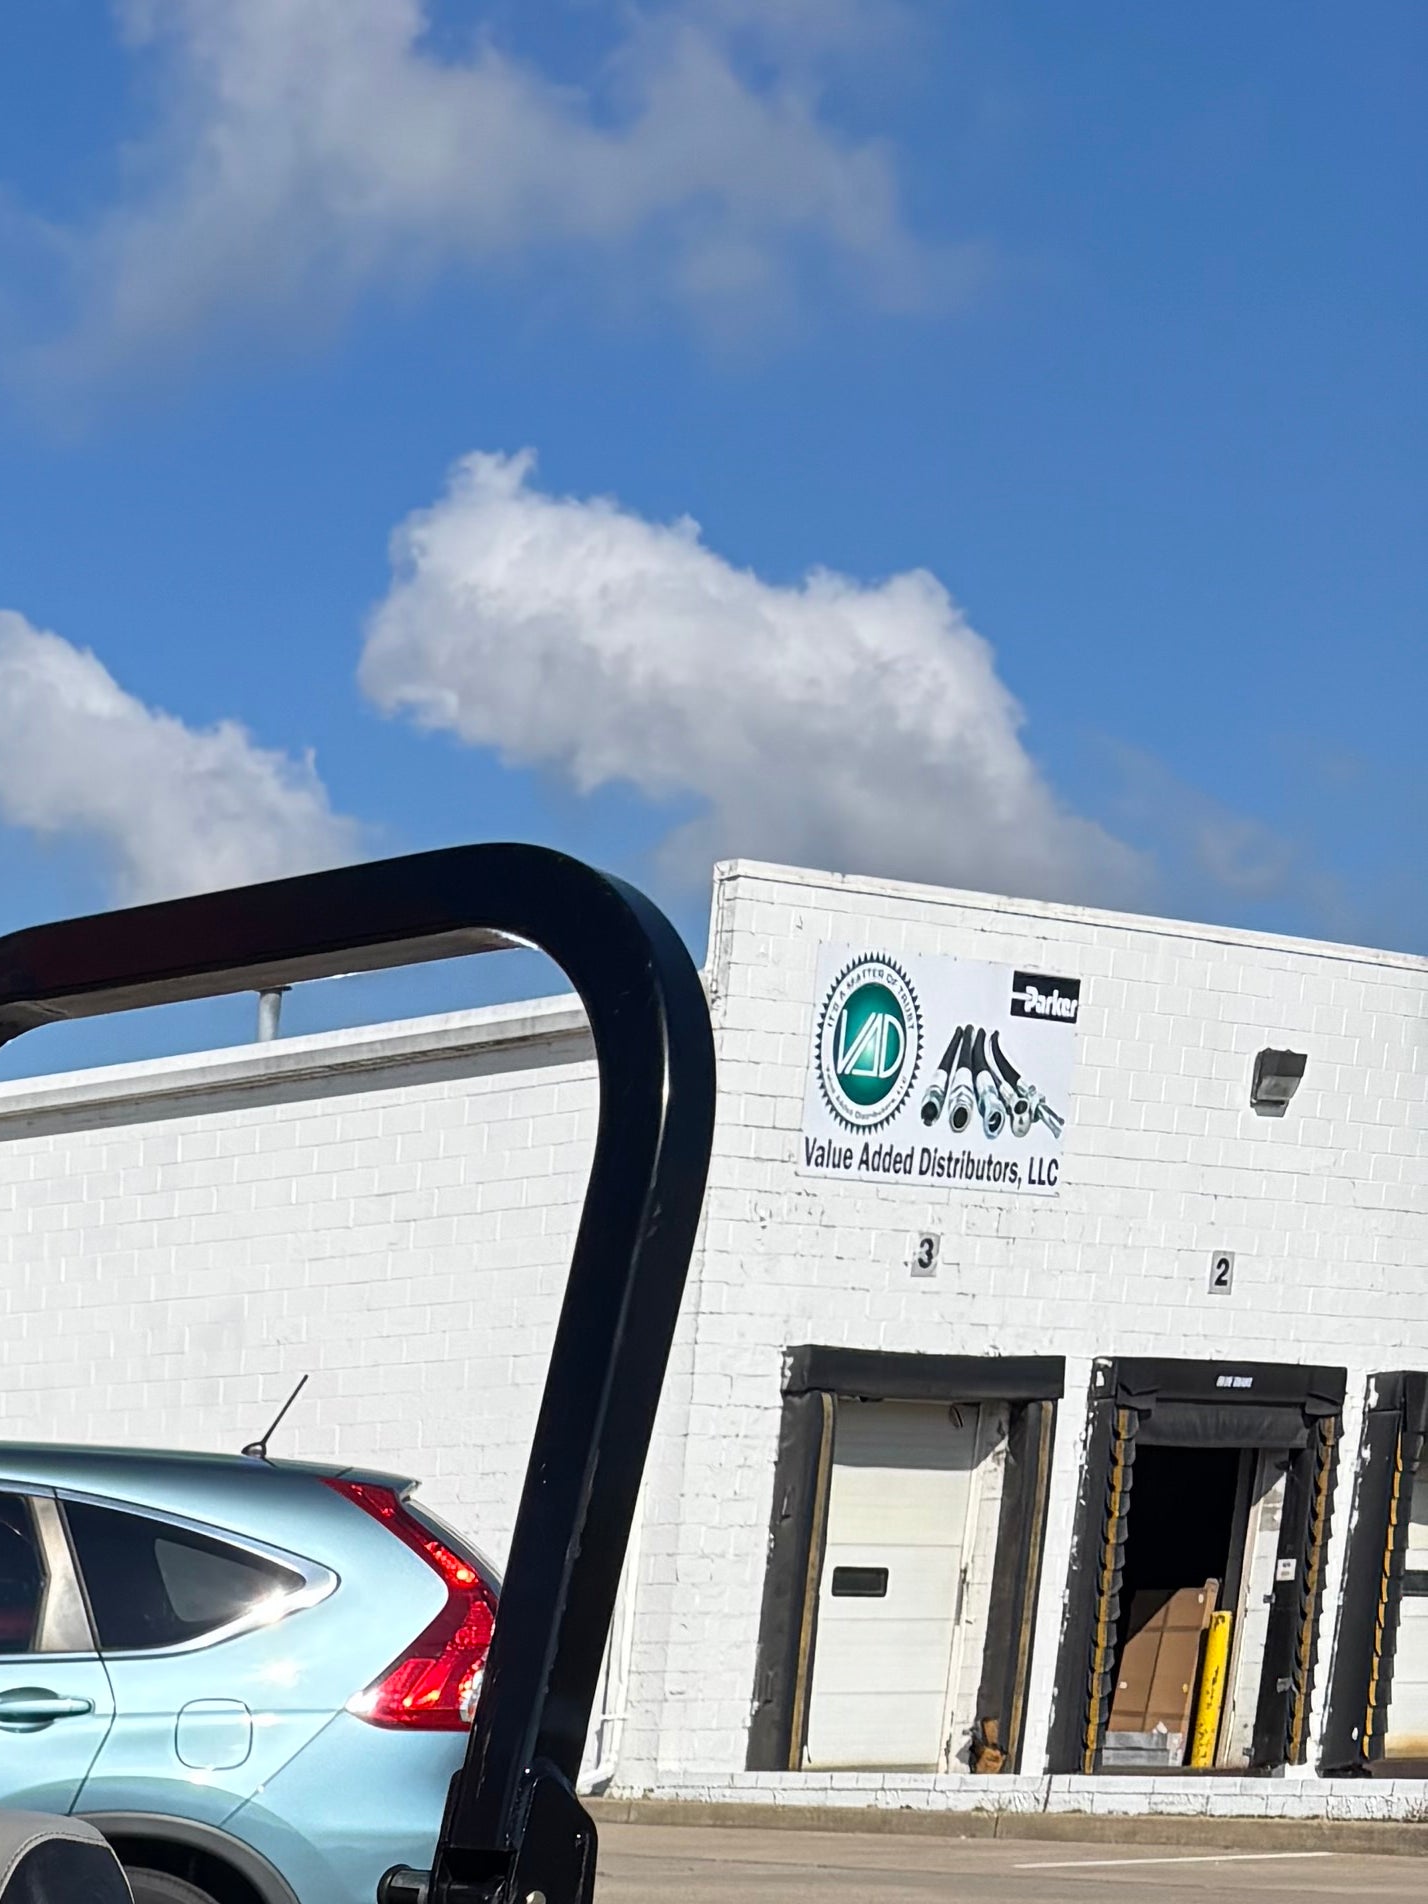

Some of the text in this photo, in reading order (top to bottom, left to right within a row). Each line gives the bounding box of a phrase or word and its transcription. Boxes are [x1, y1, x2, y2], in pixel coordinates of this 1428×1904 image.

[1023, 985, 1078, 1018] Parker
[804, 1136, 1059, 1189] Value Added Distributors, LLC
[917, 1237, 935, 1269] 3
[1213, 1257, 1230, 1287] 2
